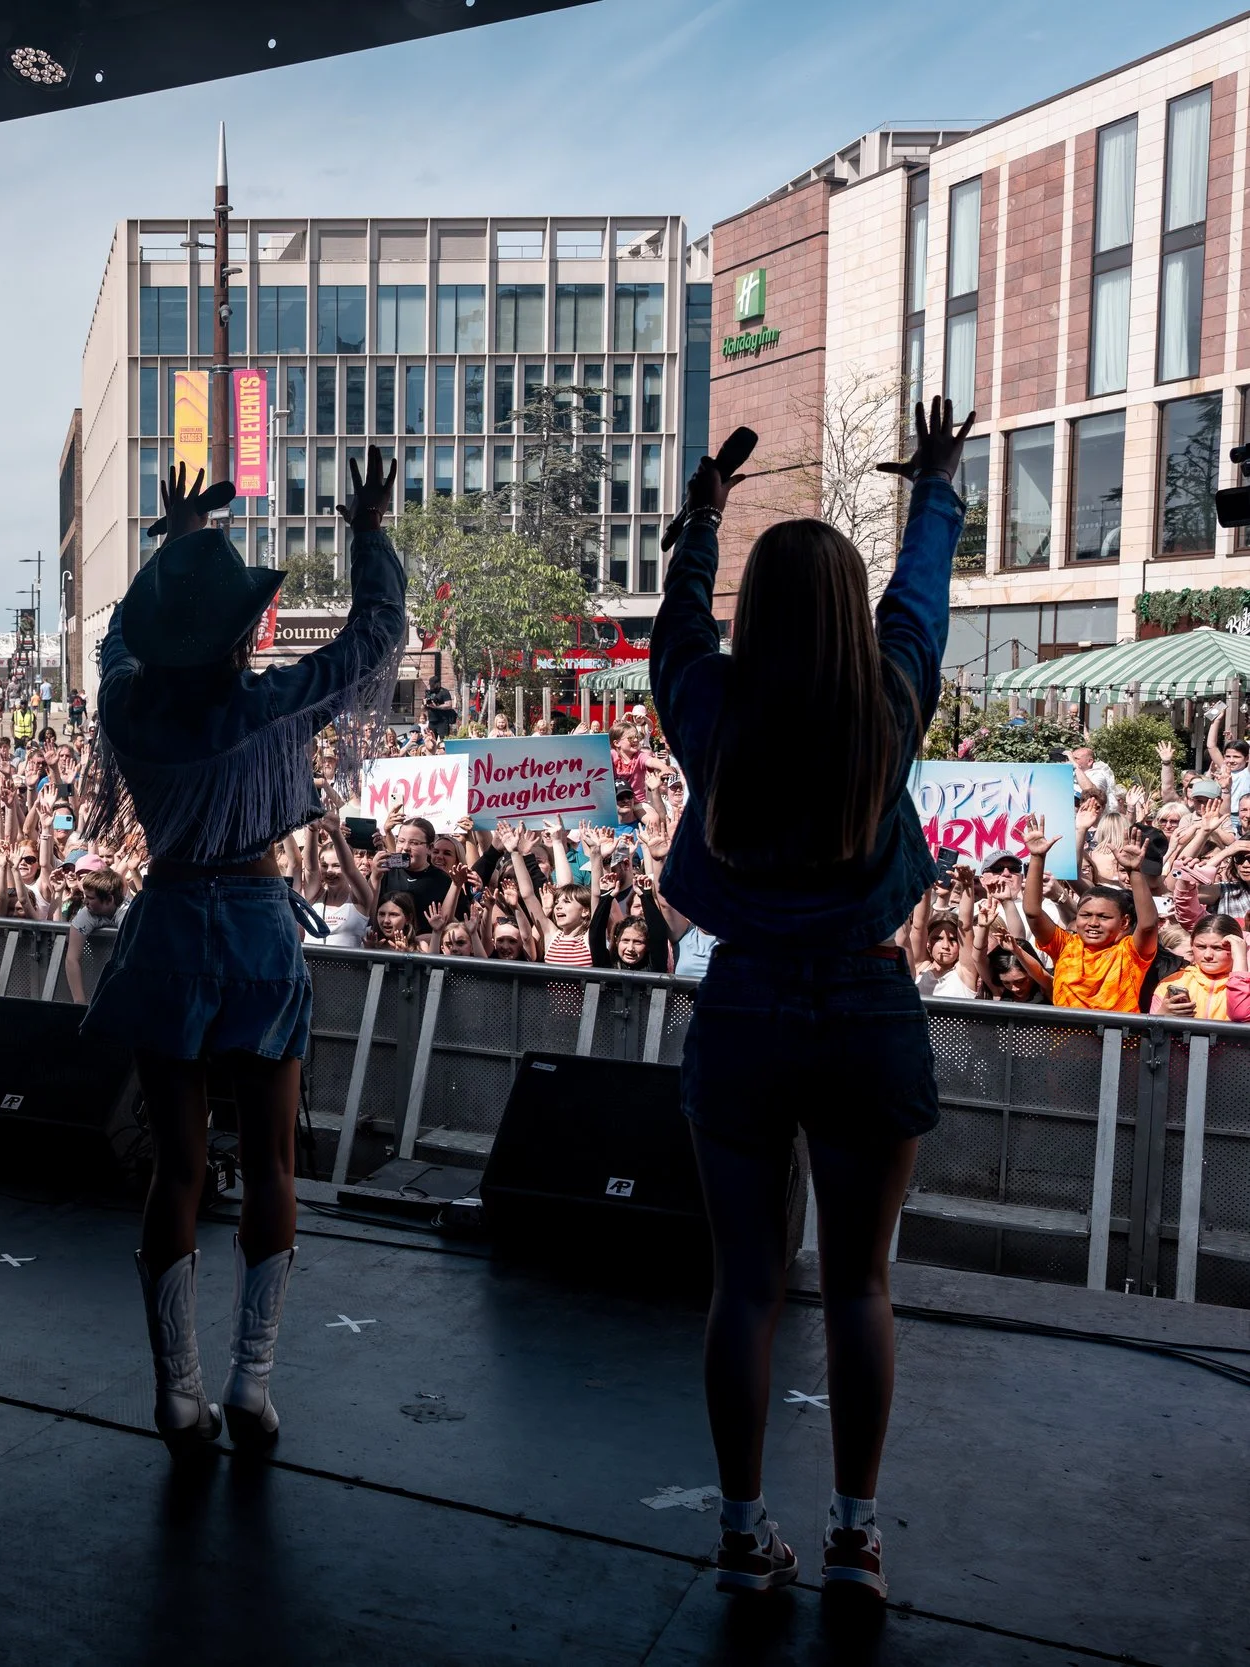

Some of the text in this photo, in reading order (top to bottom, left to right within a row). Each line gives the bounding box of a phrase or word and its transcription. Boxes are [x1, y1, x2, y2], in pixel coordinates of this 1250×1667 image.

[239, 376, 261, 432] EVENTS
[240, 434, 261, 466] LIVE
[273, 623, 344, 640] Gourme
[368, 763, 460, 816] MOLLY
[473, 752, 582, 786] Northern
[468, 777, 592, 814] Daughters
[917, 770, 1034, 820] OPEN
[923, 812, 1031, 863] ARMS
